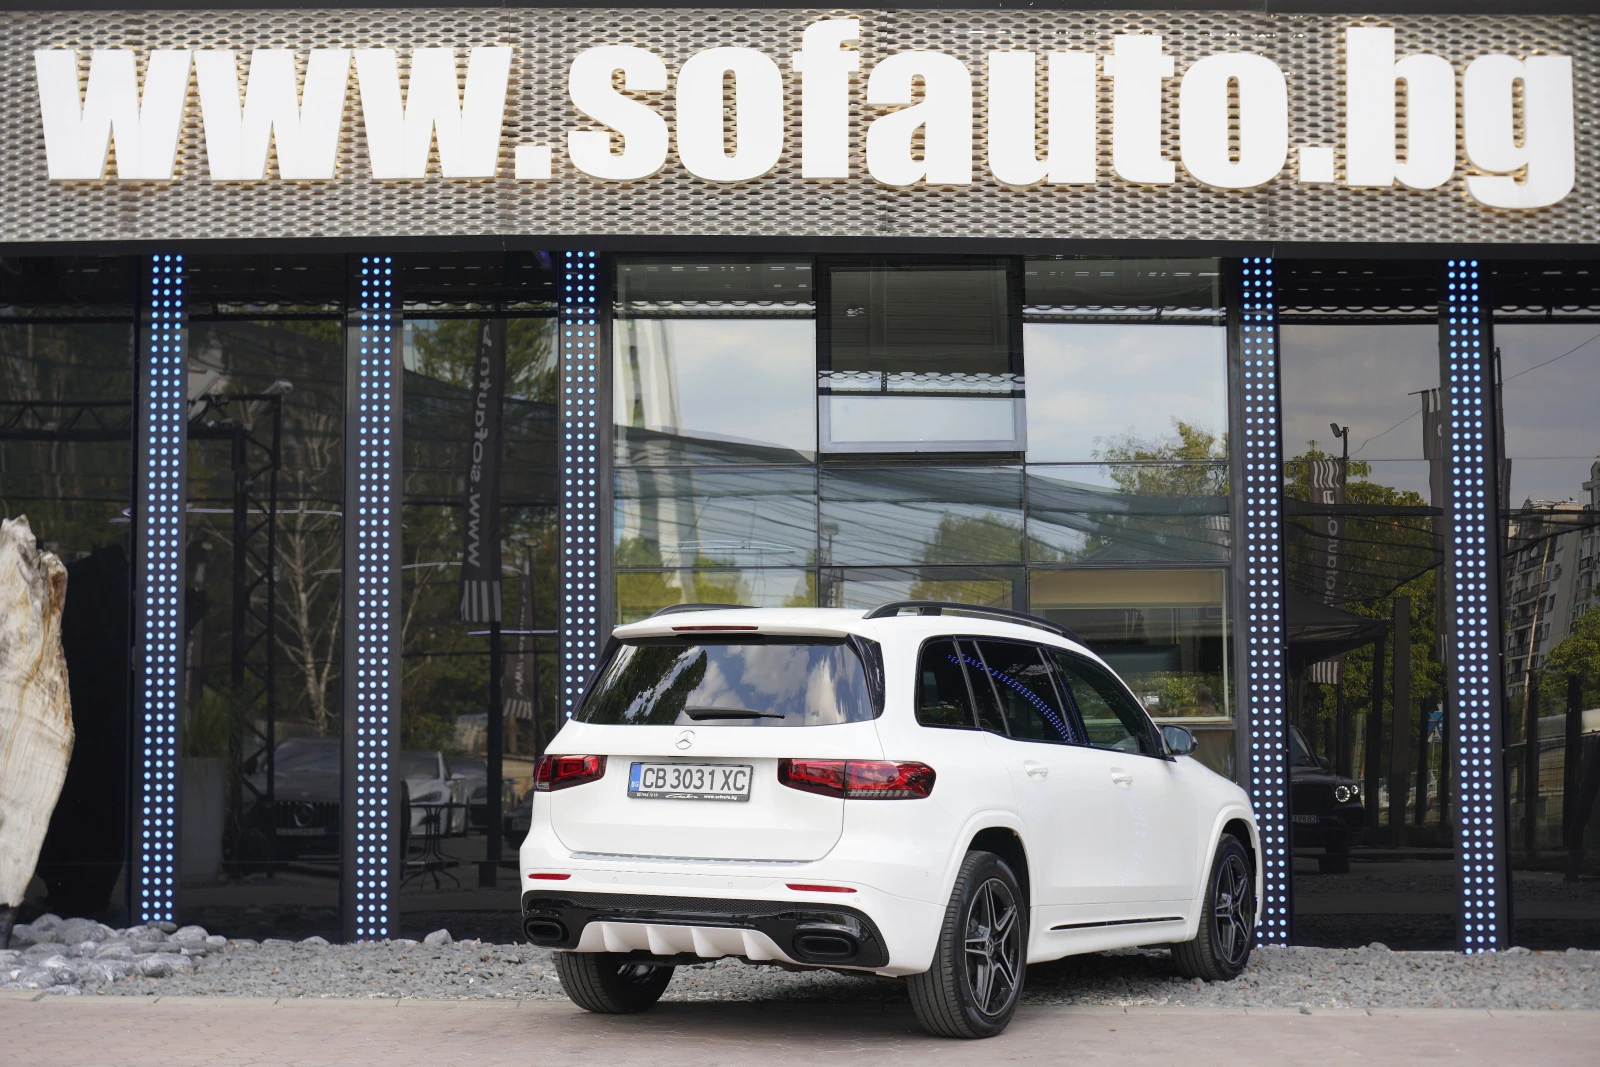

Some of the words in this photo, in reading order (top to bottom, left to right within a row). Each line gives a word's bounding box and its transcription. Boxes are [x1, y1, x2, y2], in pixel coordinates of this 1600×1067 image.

[34, 18, 1574, 208] www.sofauto.bg
[642, 767, 667, 789] CB
[670, 768, 716, 791] 3031
[720, 769, 747, 791] XC
